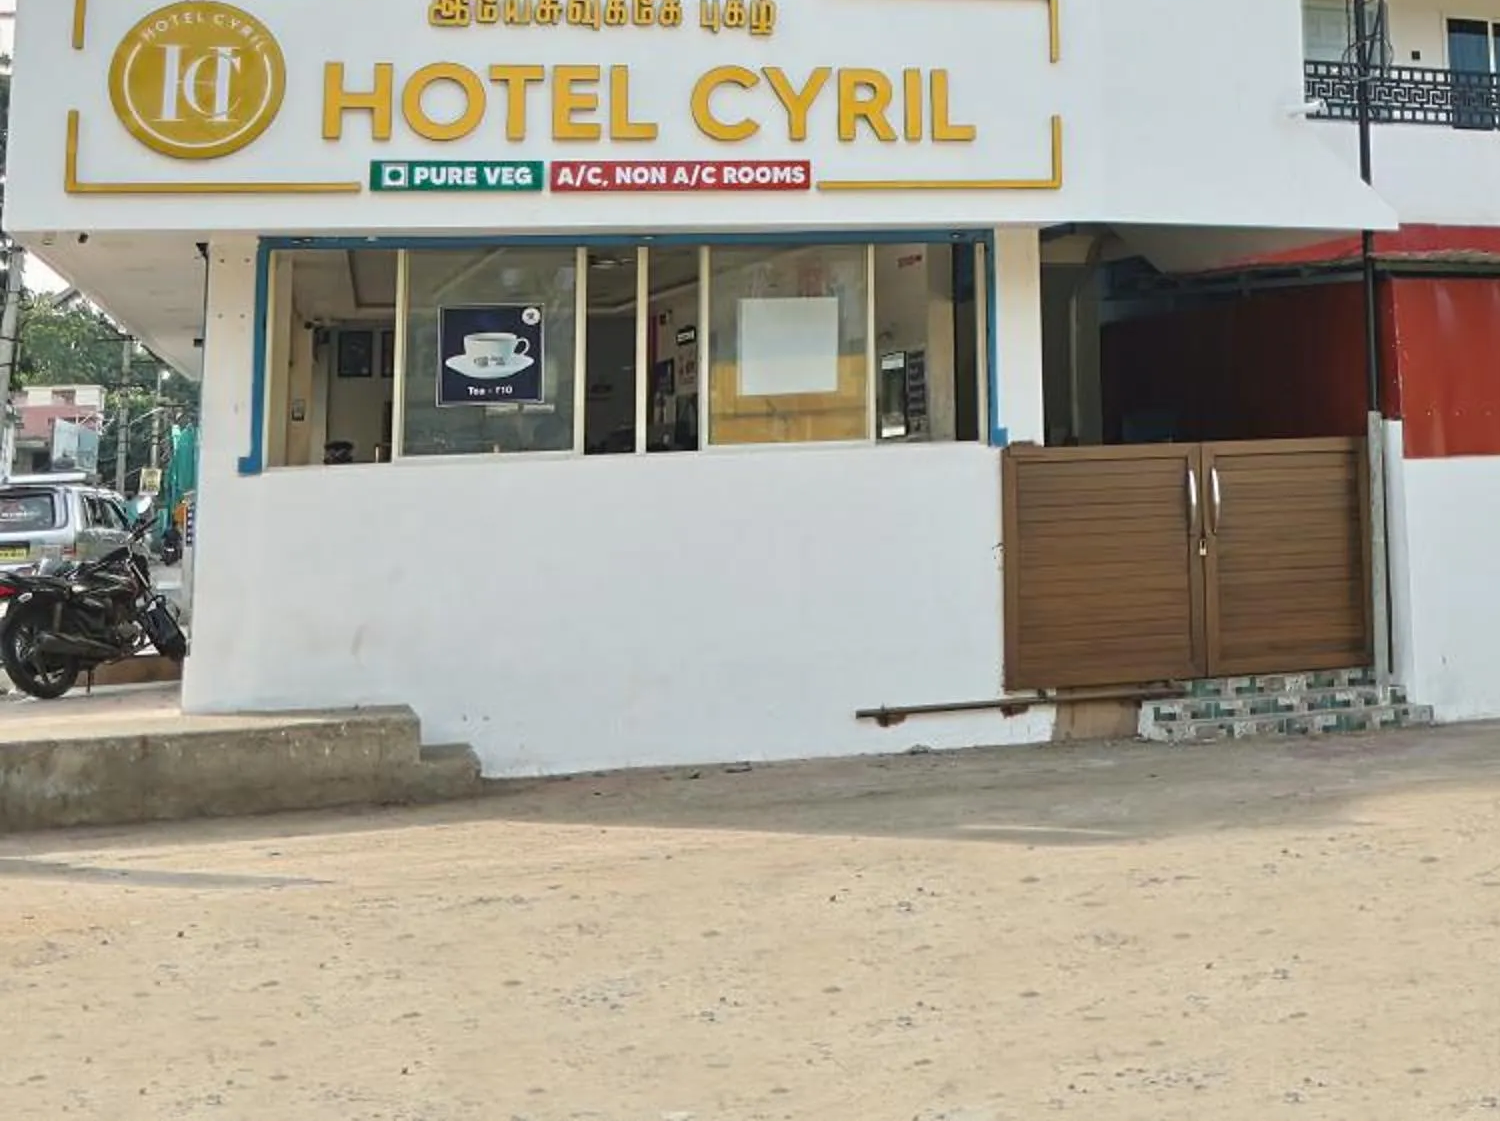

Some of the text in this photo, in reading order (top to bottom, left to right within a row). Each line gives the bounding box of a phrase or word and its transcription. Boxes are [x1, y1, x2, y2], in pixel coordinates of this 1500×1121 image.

[140, 12, 206, 43] HOTEL
[321, 61, 976, 142] HOTEL CYRIL
[413, 166, 533, 186] PURE VEG
[557, 165, 806, 187] A/C, NON A/C ROOMS
[467, 386, 486, 396] Tea
